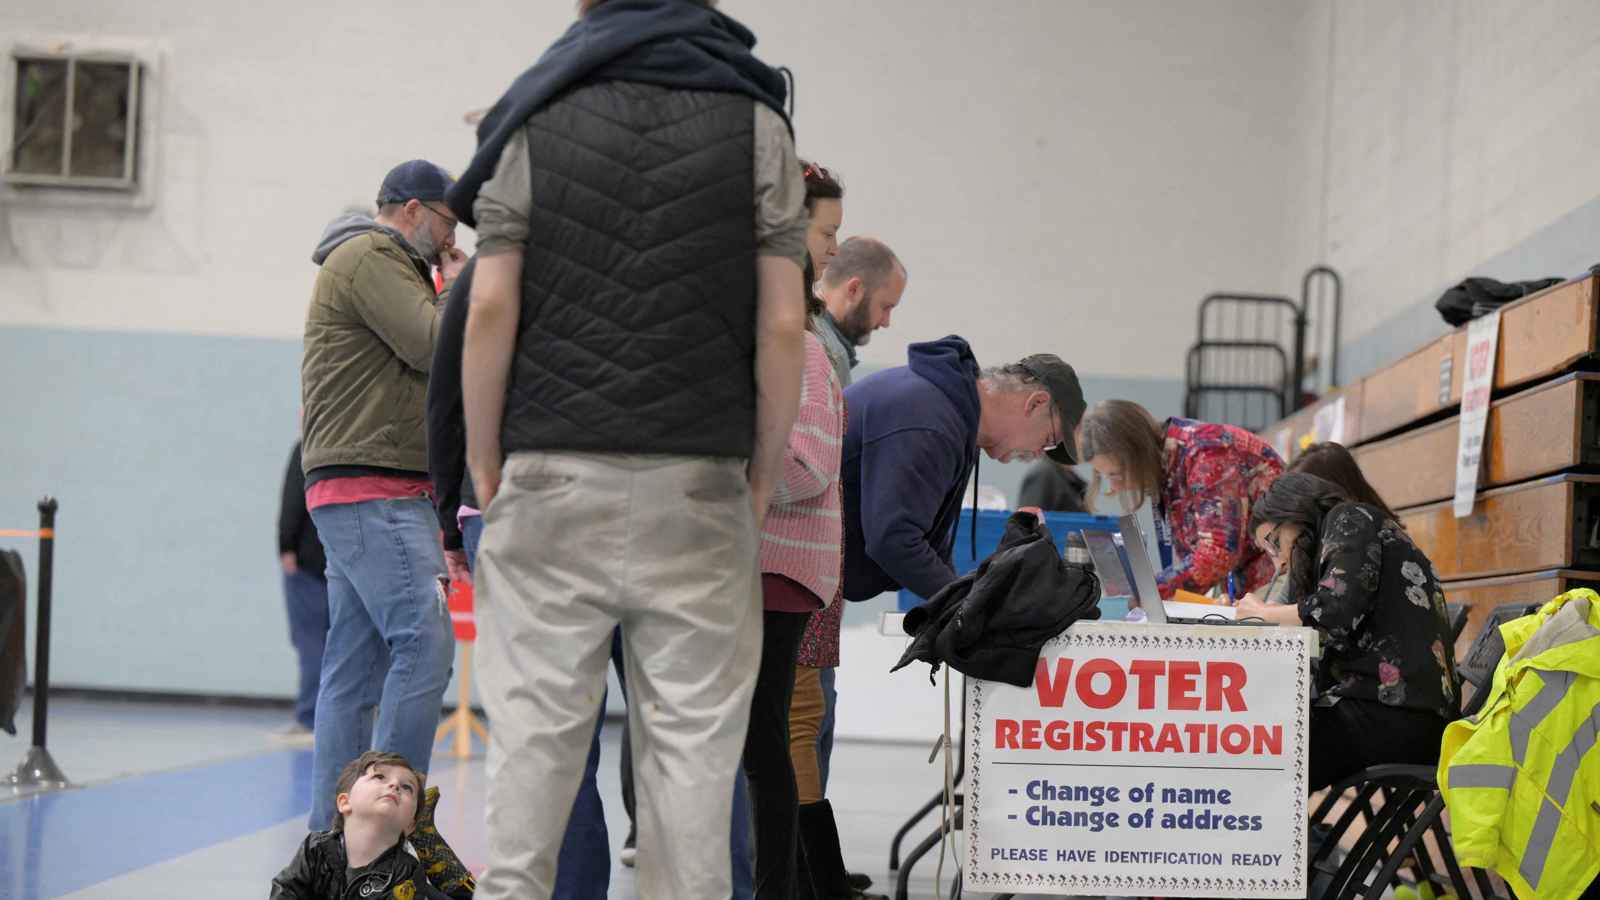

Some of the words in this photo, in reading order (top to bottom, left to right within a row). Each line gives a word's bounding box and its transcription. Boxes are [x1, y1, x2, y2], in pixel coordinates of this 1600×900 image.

[1035, 657, 1249, 712] VOTER
[994, 719, 1284, 756] REGISTRATION
[1025, 779, 1121, 807] Change
[1128, 782, 1155, 804] of
[1161, 787, 1232, 805] name
[1025, 805, 1121, 833] Change
[1127, 808, 1155, 829] of
[1160, 808, 1263, 832] address
[990, 847, 1048, 862] PLEASE
[1056, 849, 1097, 863] HAVE
[1104, 850, 1223, 865] IDENTIFICATION
[1231, 853, 1283, 867] READY
